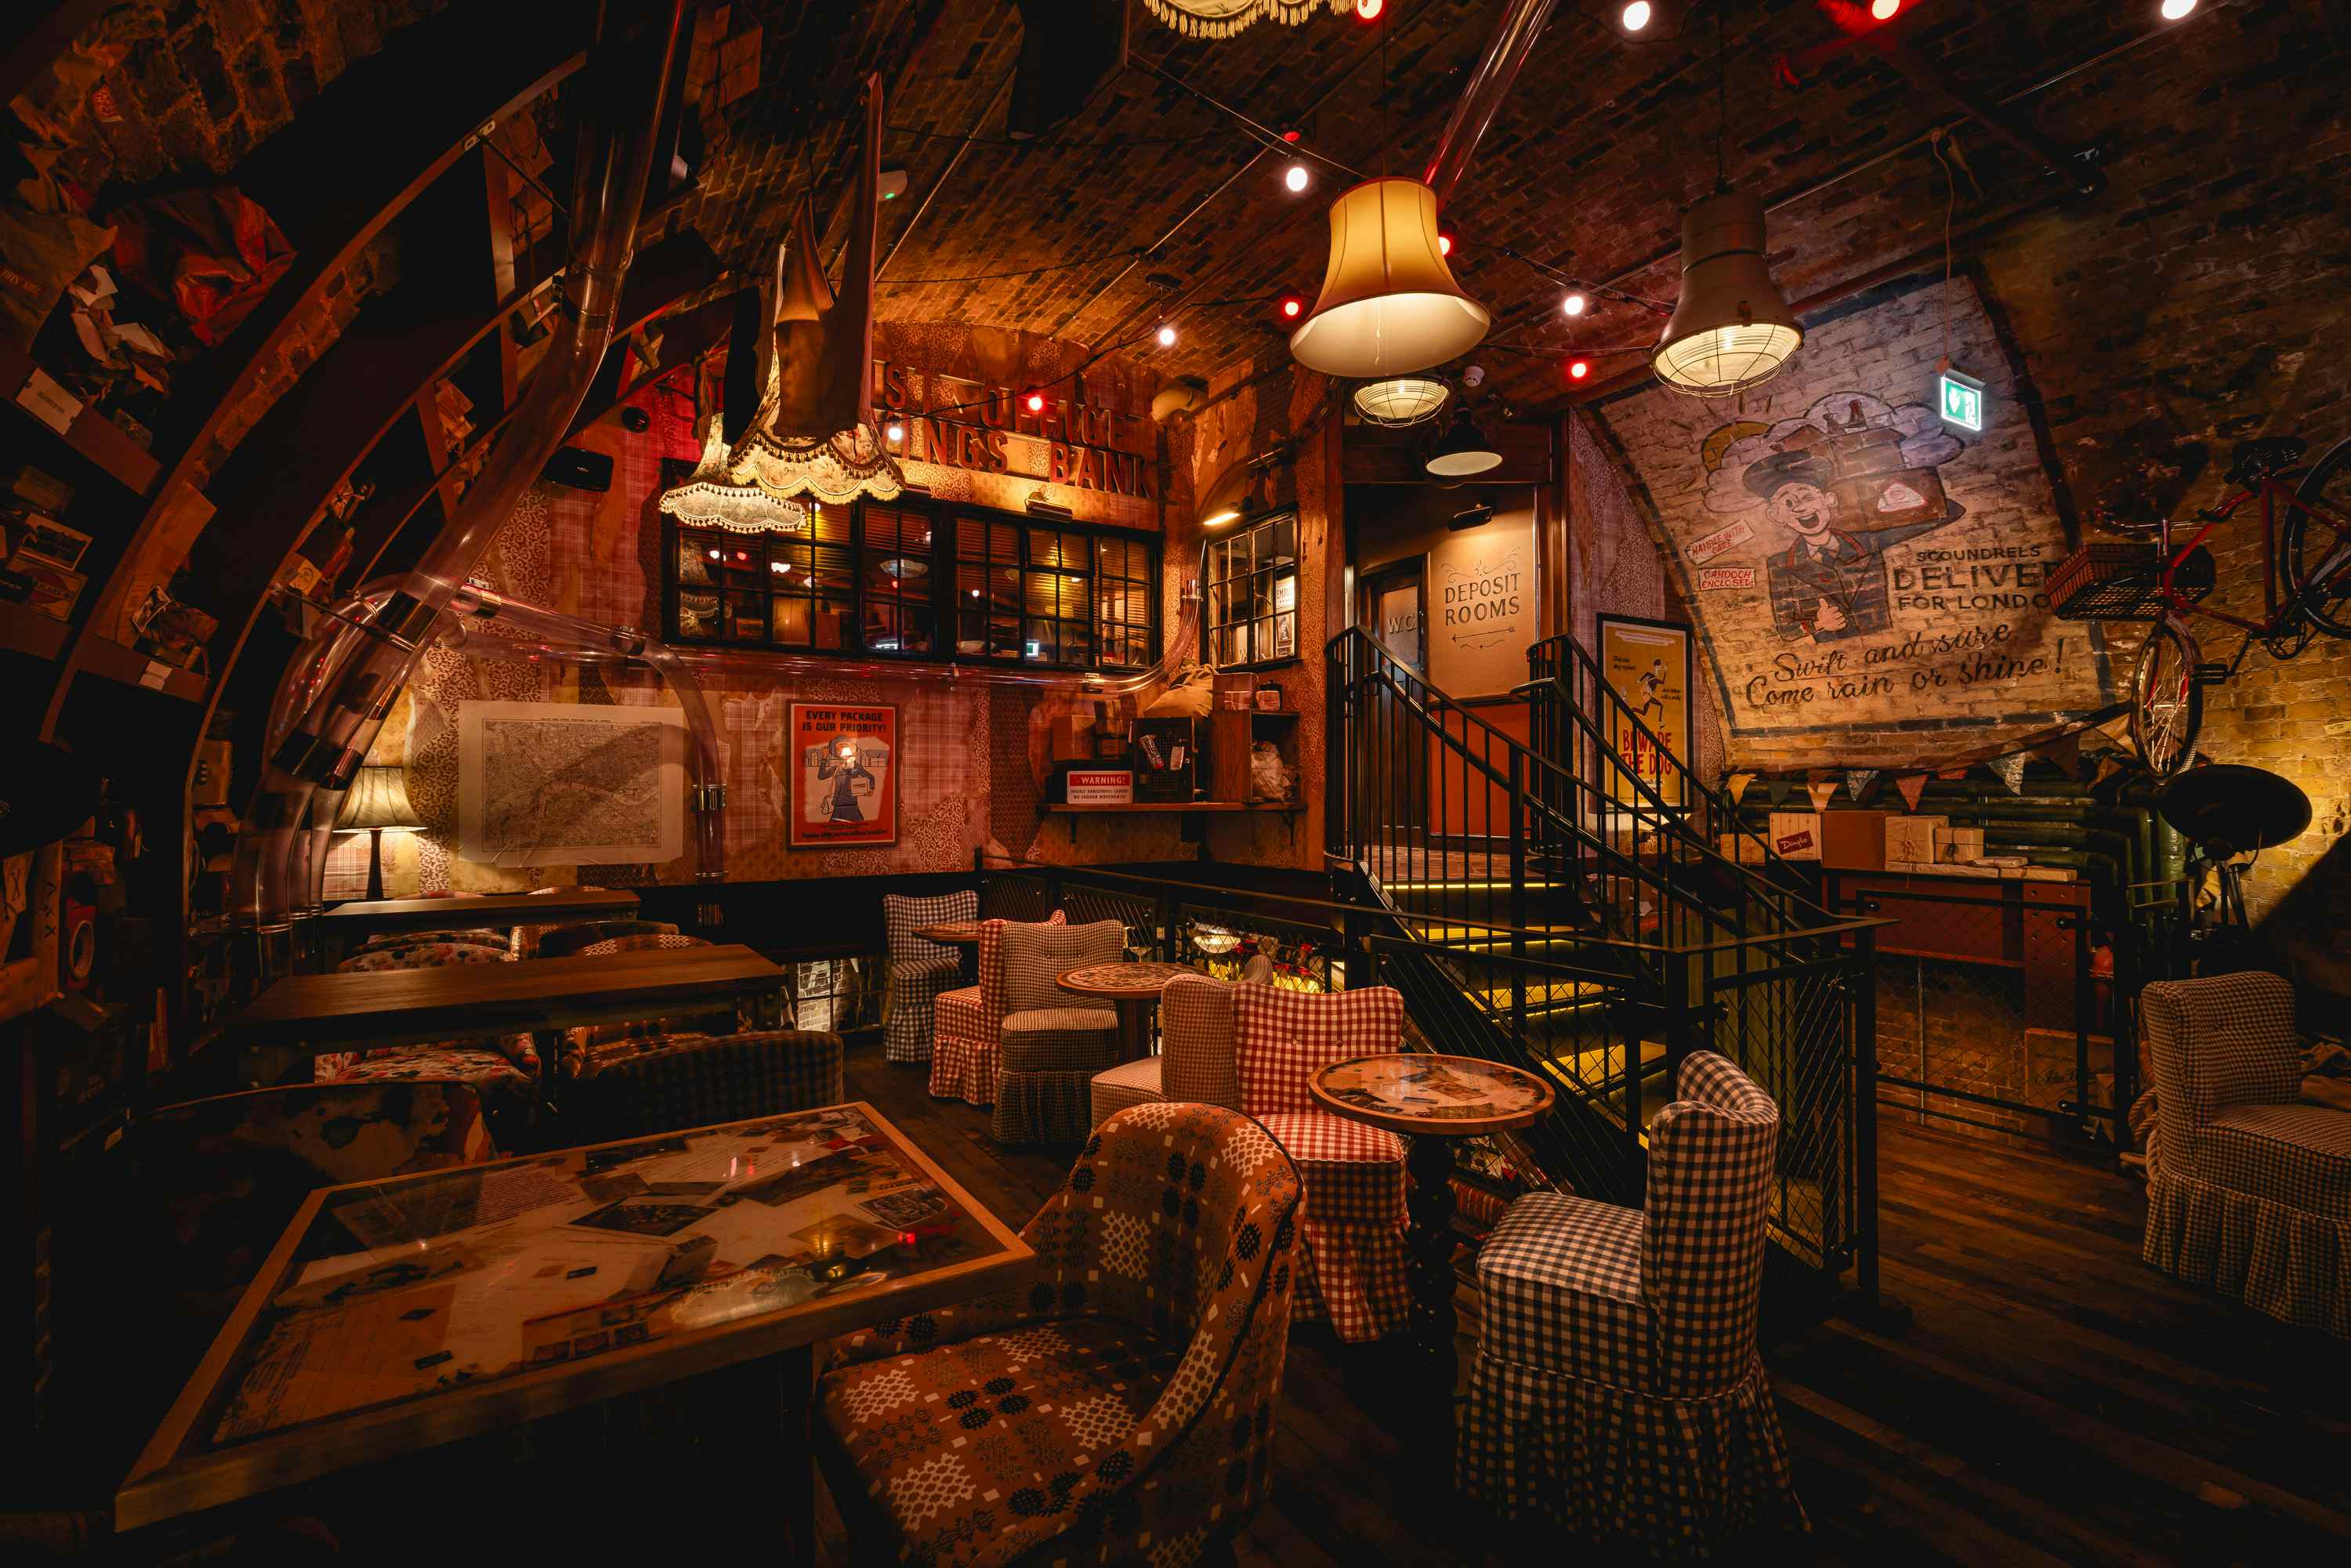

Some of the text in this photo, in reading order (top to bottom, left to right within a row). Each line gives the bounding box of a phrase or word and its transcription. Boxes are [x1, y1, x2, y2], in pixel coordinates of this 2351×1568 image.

[1050, 441, 1152, 499] BANK
[1916, 545, 2041, 563] SCOUNDRELS
[1444, 573, 1521, 603] DEPOSIT
[1899, 590, 2051, 611] FOR LONDO
[1445, 596, 1520, 627] ROOMS
[1773, 619, 2012, 683] Swift and sure
[1744, 675, 1814, 706] Come
[1826, 674, 1895, 702] rain
[1911, 669, 1947, 691] or
[802, 722, 886, 733] IS OUR PRIORITY!
[806, 711, 883, 722] EVERY PACKAGE
